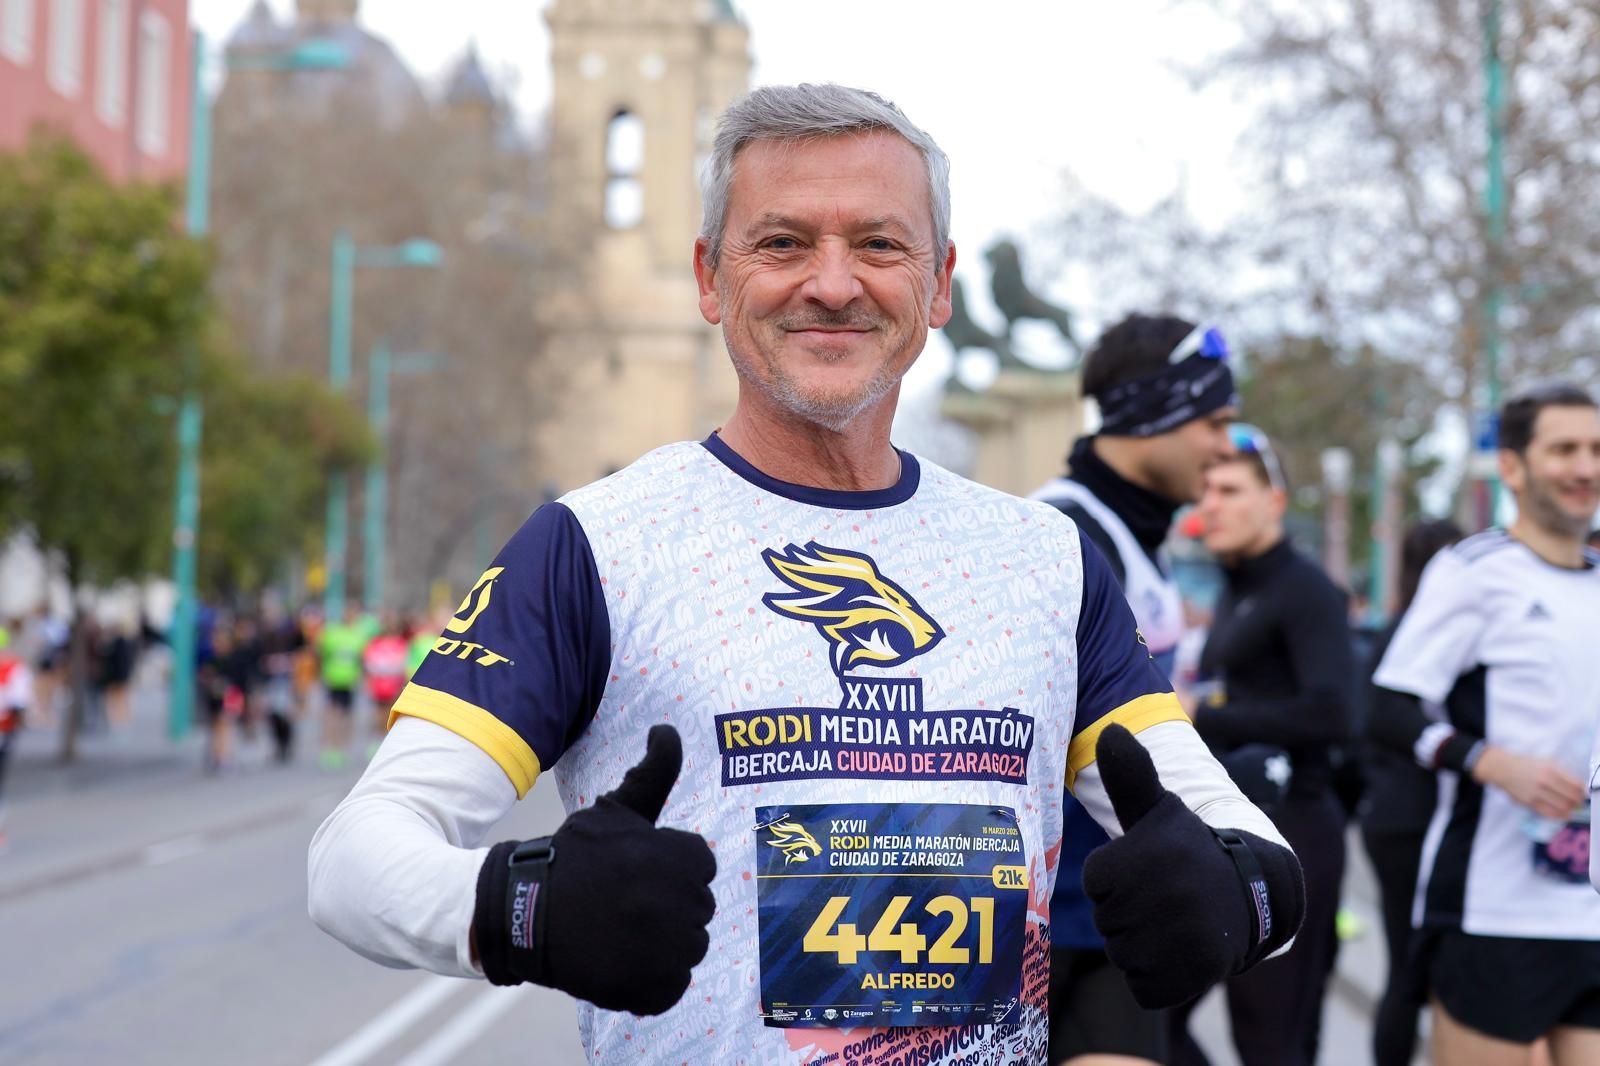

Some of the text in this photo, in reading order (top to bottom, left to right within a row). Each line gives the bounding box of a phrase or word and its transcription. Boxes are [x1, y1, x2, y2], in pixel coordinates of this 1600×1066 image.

[432, 637, 510, 666] OTT
[846, 682, 916, 712] XXVII
[723, 713, 1032, 749] RODI MEDIA MARATÓN
[728, 750, 832, 779] IBERCAJA
[837, 750, 907, 773] CIUDAD
[912, 752, 936, 774] DE
[830, 820, 866, 833] XXVII
[988, 826, 1006, 835] MARZO
[830, 833, 1020, 853] RODI MEDIA MARATÓN IBERCAJA
[830, 852, 964, 867] CIUDAD DE ZARAGOZA
[998, 870, 1024, 886] 21k
[511, 881, 528, 948] SPORT
[803, 895, 995, 965] 4421
[861, 973, 955, 990] ALFREDO
[850, 1010, 874, 1018] Zaragoza
